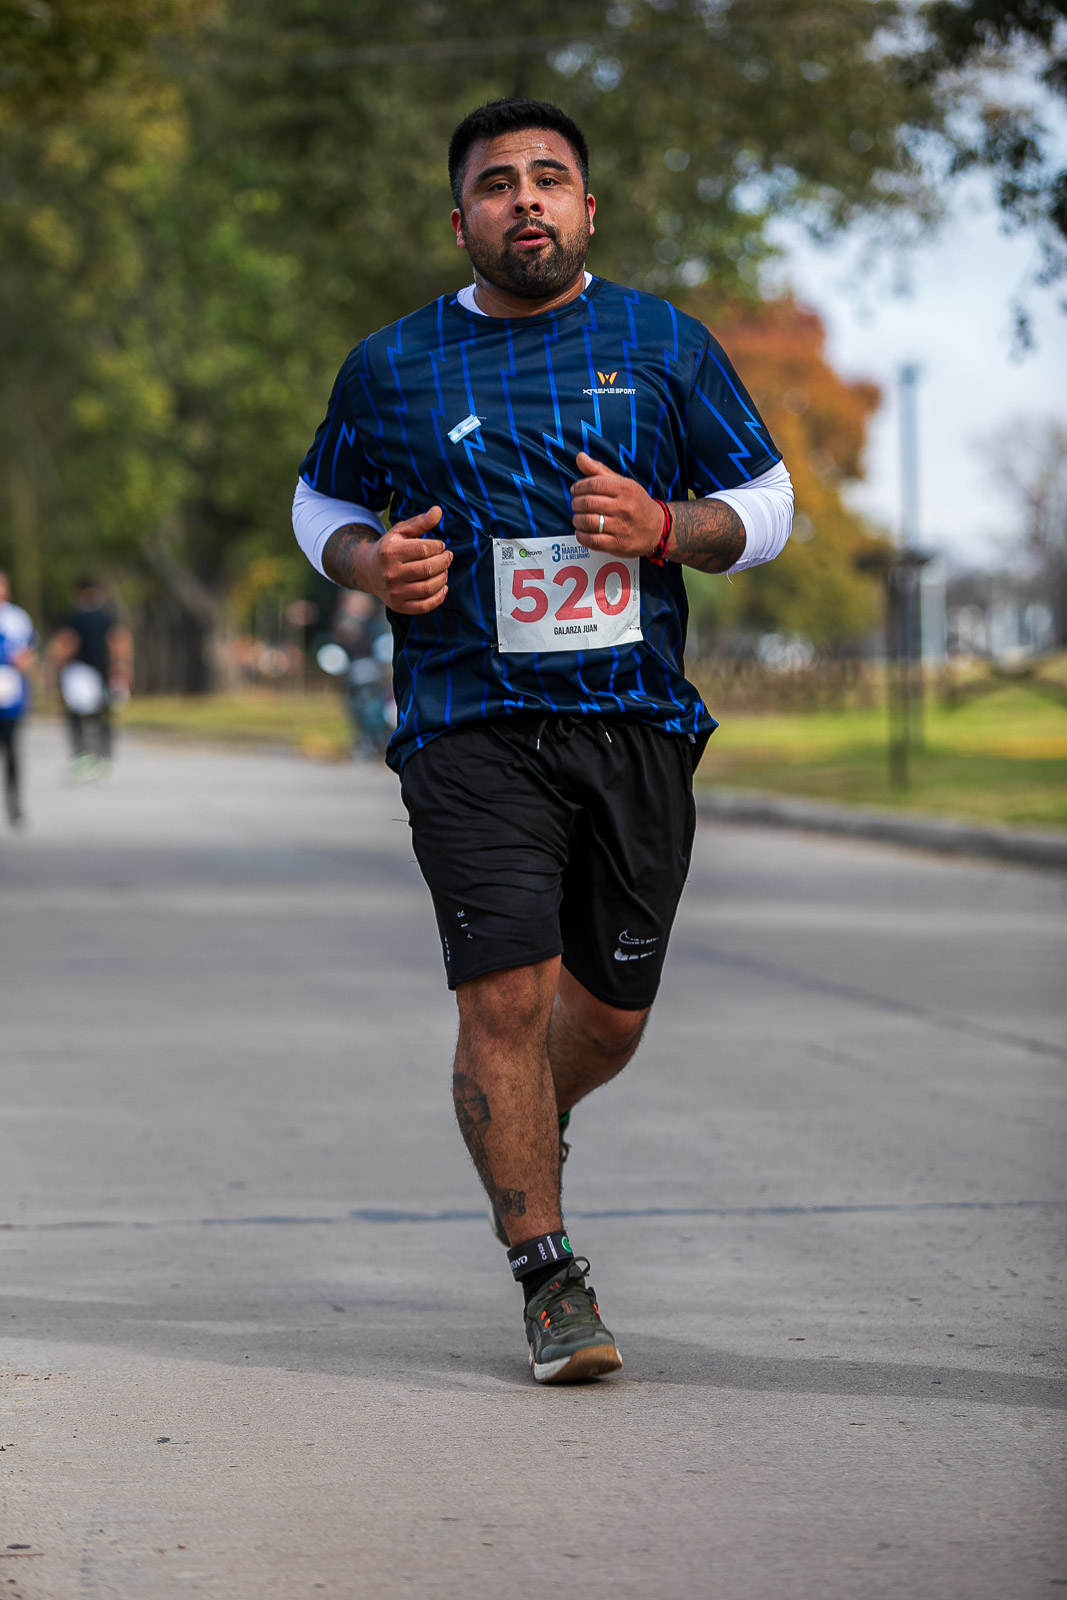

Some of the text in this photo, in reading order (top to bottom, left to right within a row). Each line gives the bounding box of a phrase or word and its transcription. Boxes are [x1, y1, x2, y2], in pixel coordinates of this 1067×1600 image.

[582, 388, 614, 396] XTREME
[510, 561, 631, 623] 520
[554, 624, 598, 635] GALARZA JUAN
